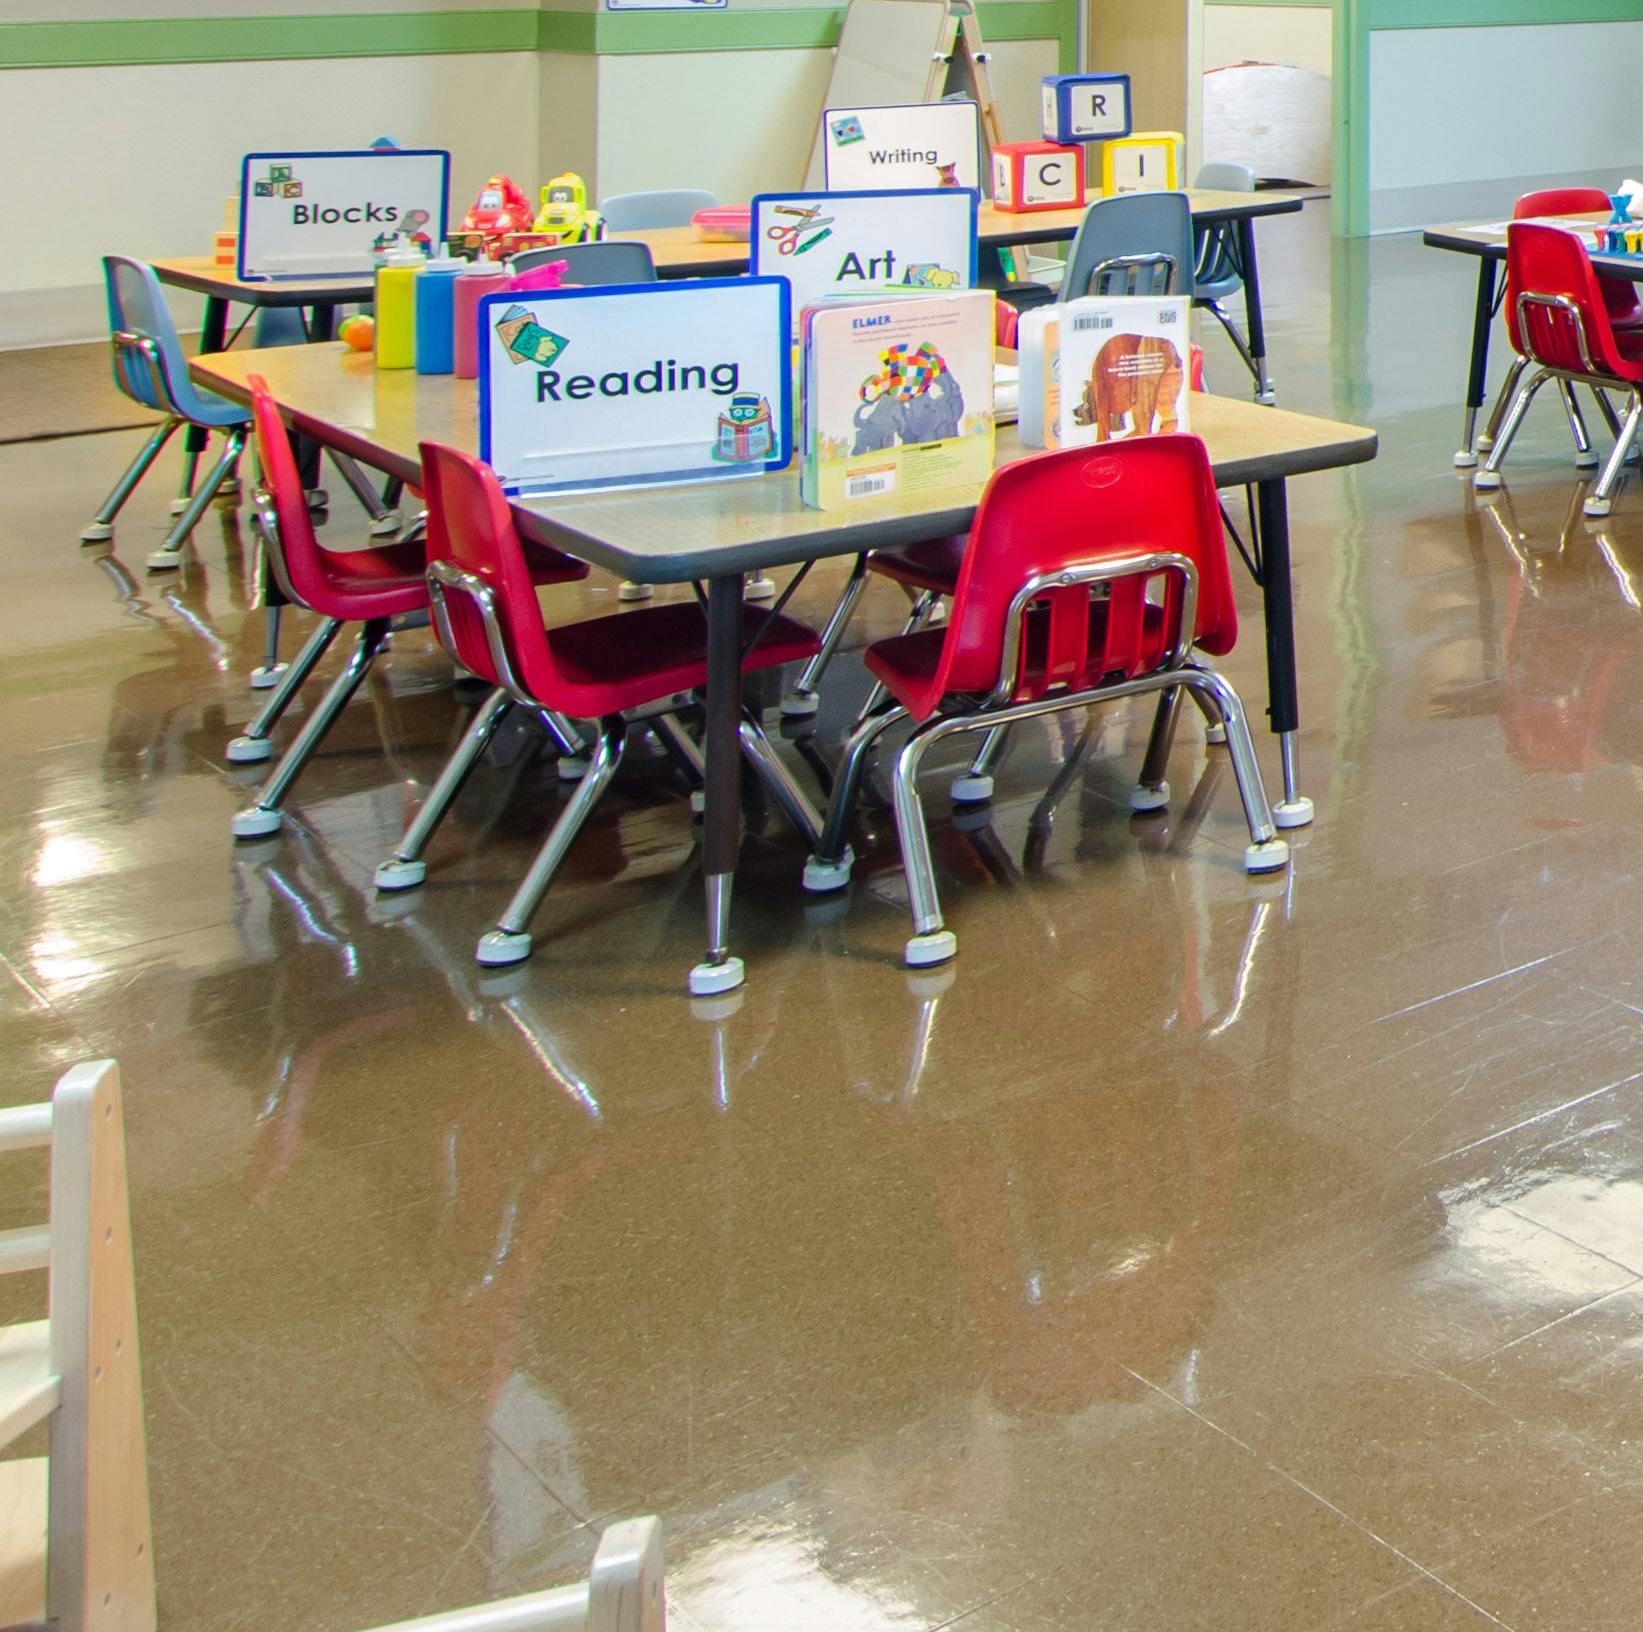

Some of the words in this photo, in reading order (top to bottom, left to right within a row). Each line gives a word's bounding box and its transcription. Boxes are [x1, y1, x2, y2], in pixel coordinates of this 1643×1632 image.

[1091, 94, 1107, 117] R
[868, 146, 938, 167] Writing
[1039, 162, 1062, 186] C
[291, 200, 399, 226] Blocks
[836, 249, 896, 280] Art
[852, 315, 892, 329] ELMER
[536, 357, 741, 404] Reading
